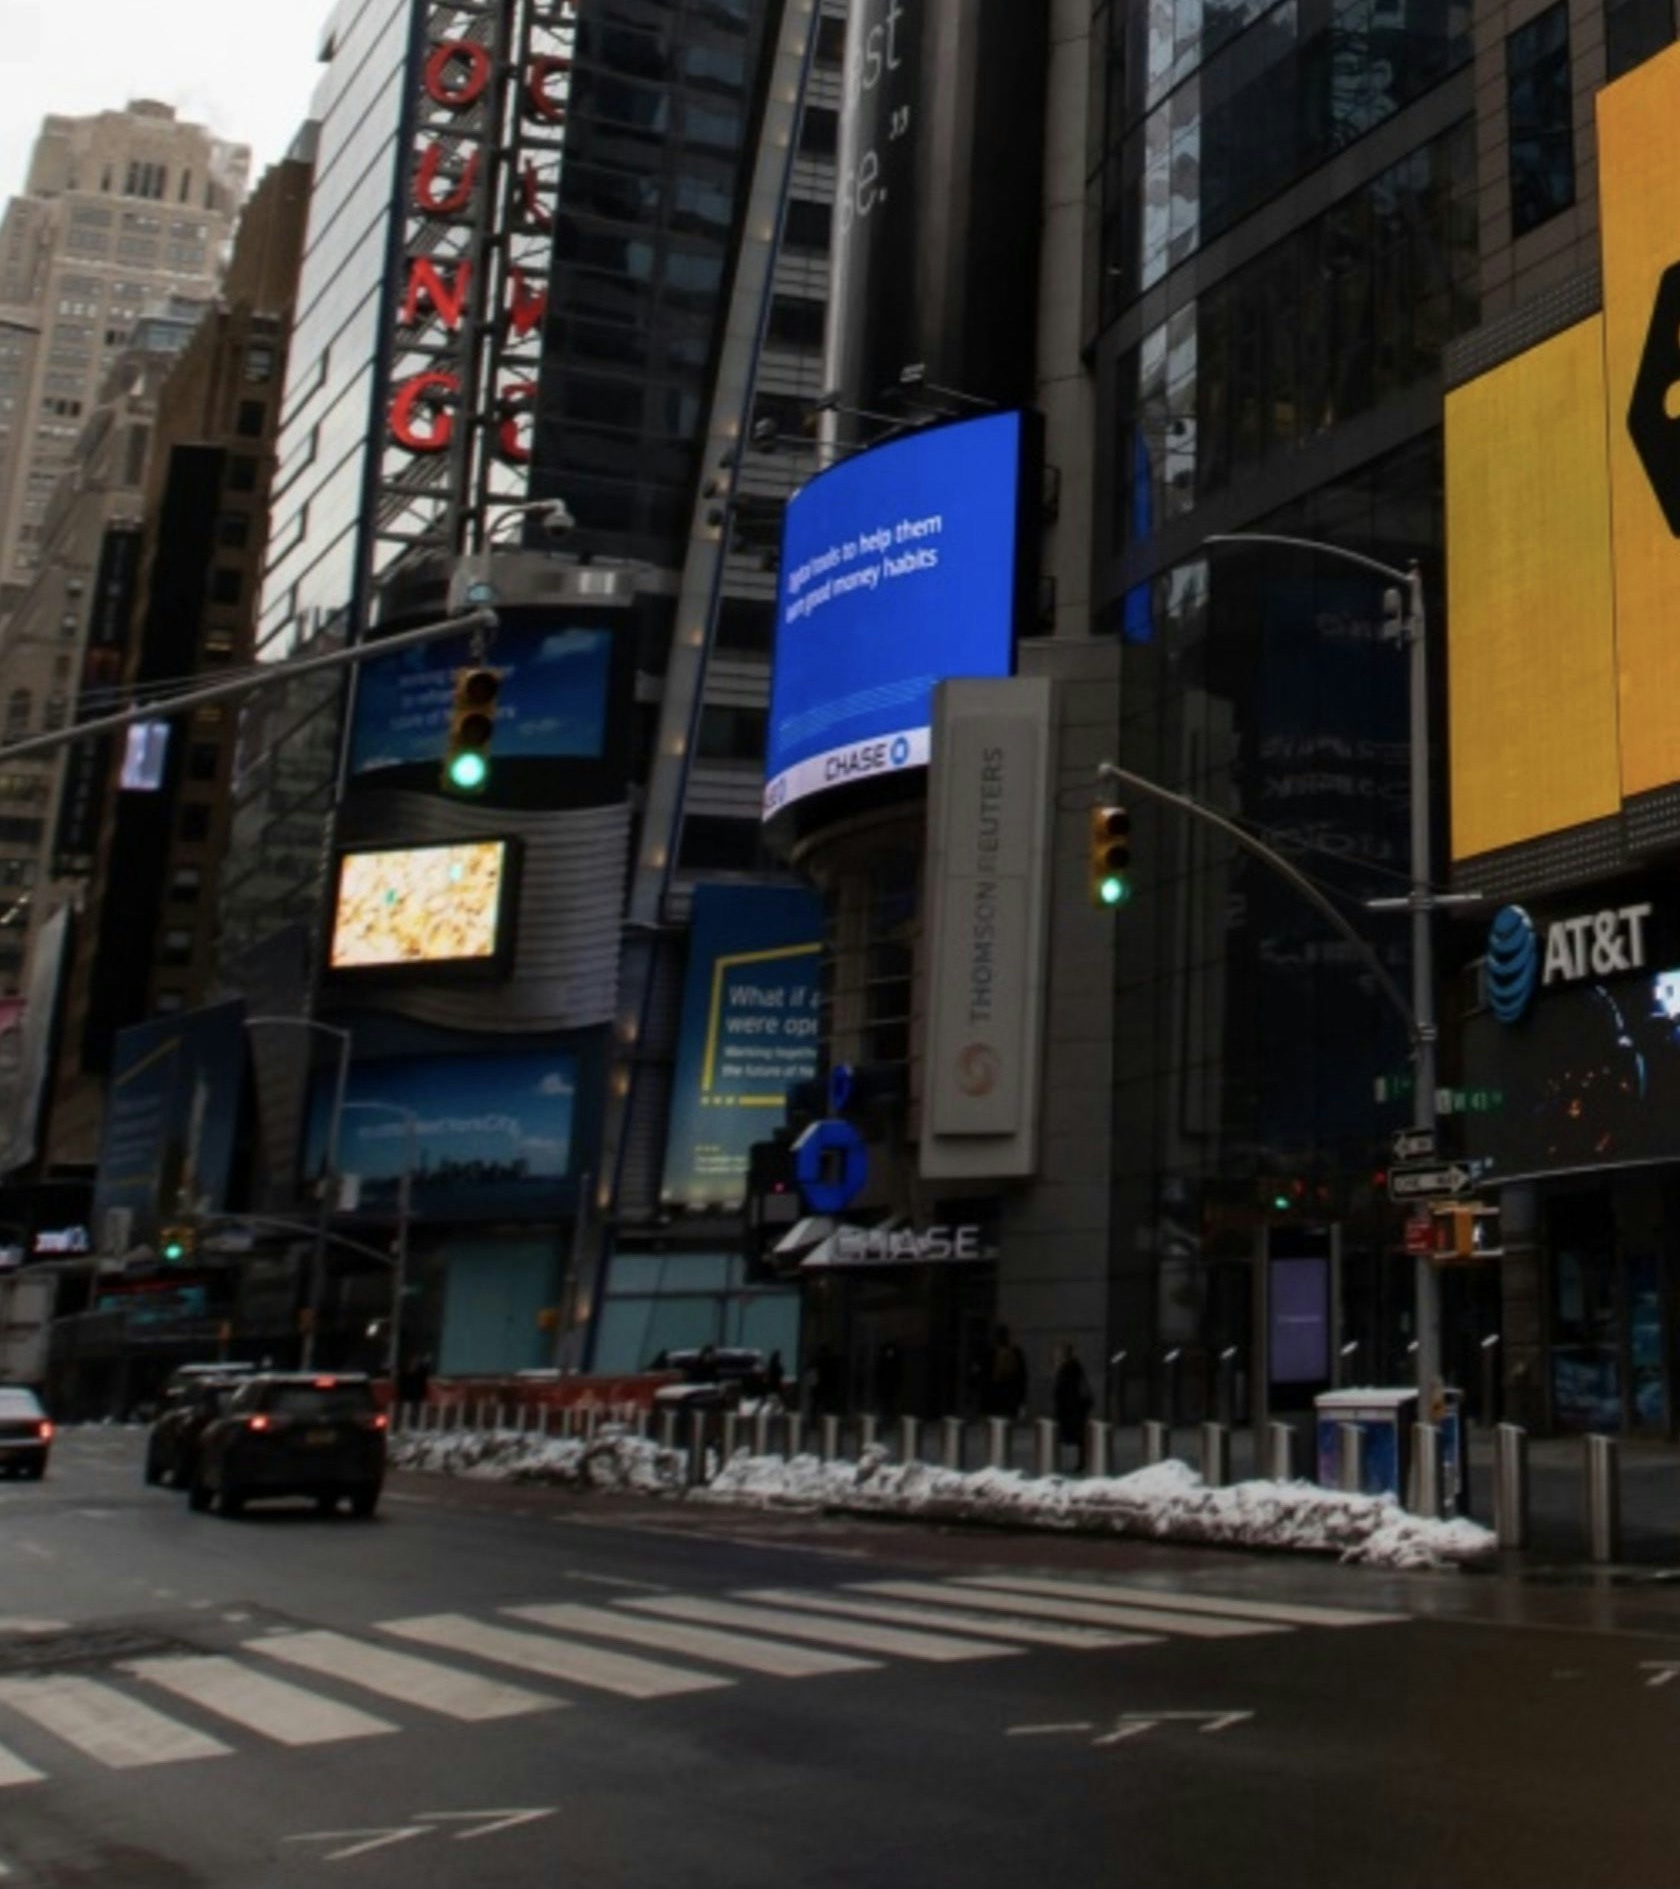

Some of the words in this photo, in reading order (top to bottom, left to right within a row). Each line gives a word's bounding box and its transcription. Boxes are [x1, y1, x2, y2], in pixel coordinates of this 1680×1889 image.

[860, 526, 891, 556] help
[896, 515, 942, 544] them
[833, 564, 880, 597] money
[883, 547, 938, 579] habits
[824, 741, 887, 782] CHASE
[969, 880, 998, 1027] THOMSON
[1540, 900, 1654, 987] AT&T
[728, 984, 784, 1009] What
[725, 1014, 780, 1035] were
[833, 1222, 981, 1264] CHASE
